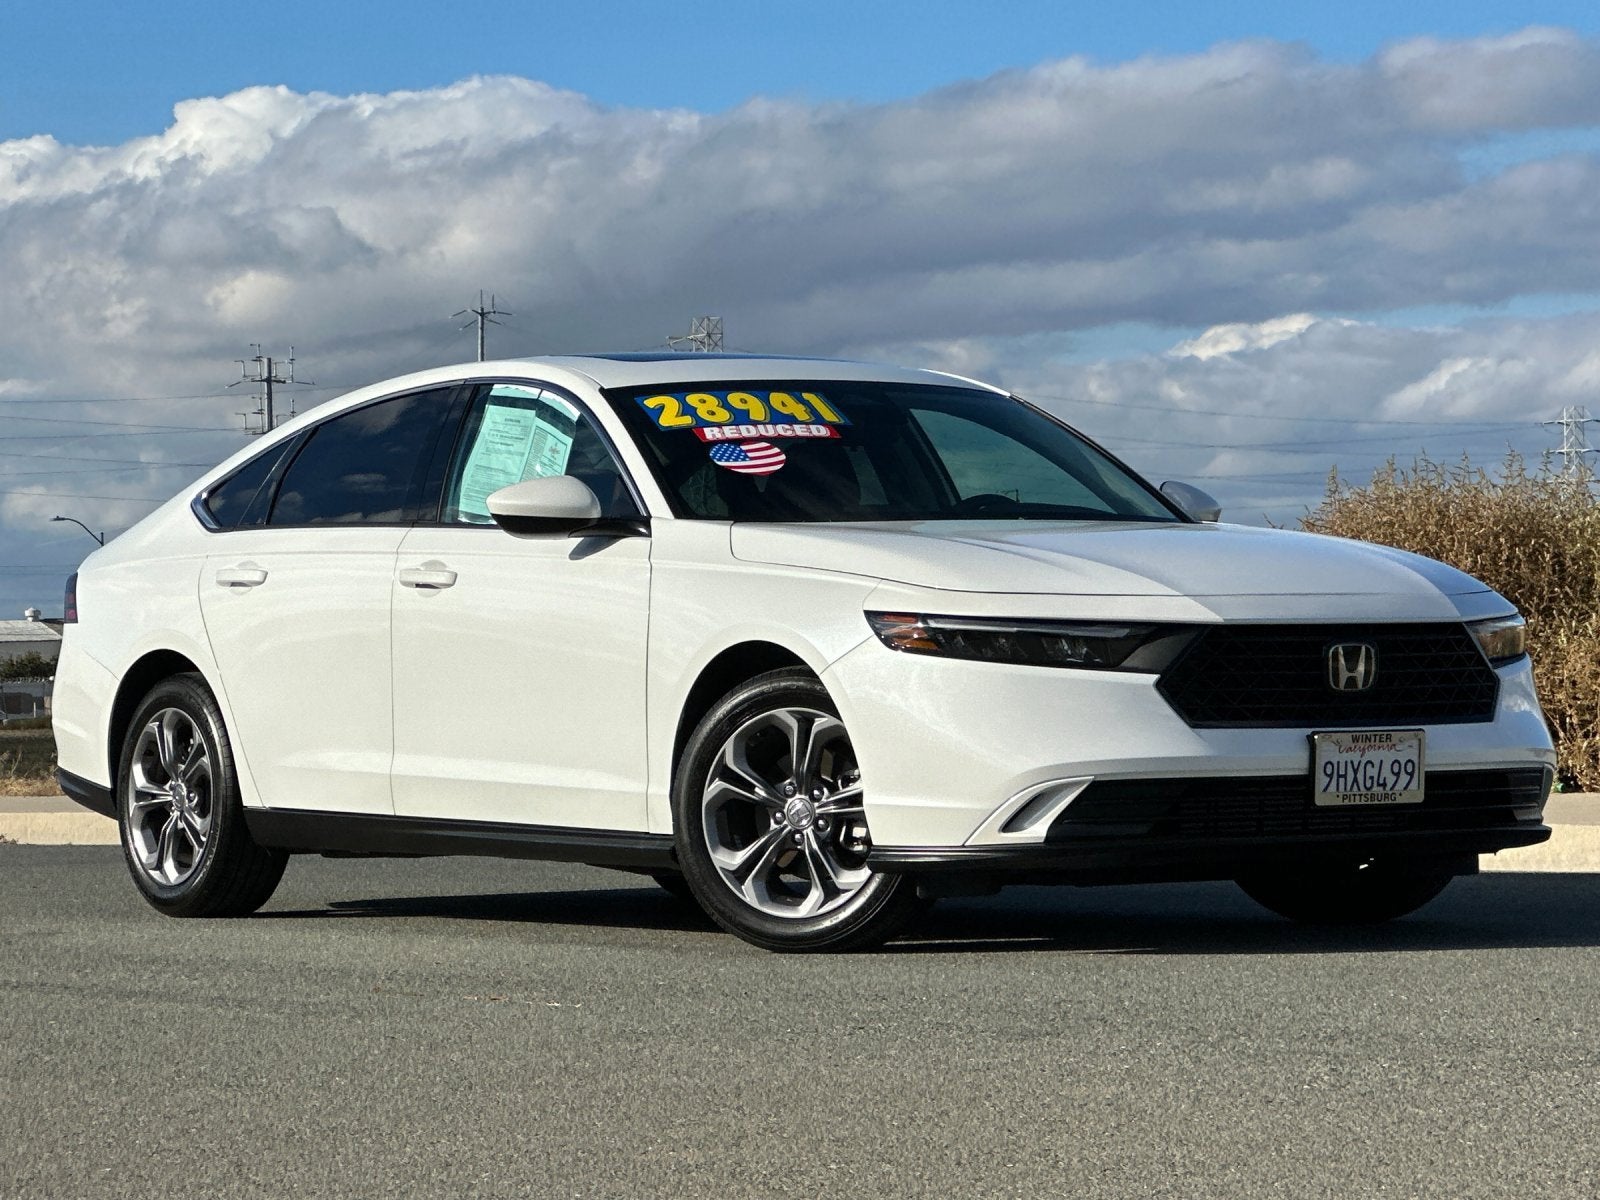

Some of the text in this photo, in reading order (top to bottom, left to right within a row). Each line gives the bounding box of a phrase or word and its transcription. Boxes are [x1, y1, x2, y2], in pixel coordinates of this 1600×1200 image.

[642, 391, 845, 428] 28941
[703, 424, 831, 440] REDUCED
[1351, 733, 1392, 743] WINTER
[1338, 743, 1402, 758] California
[1322, 759, 1416, 792] 9HXG499
[1341, 793, 1397, 803] PITTSBURG
